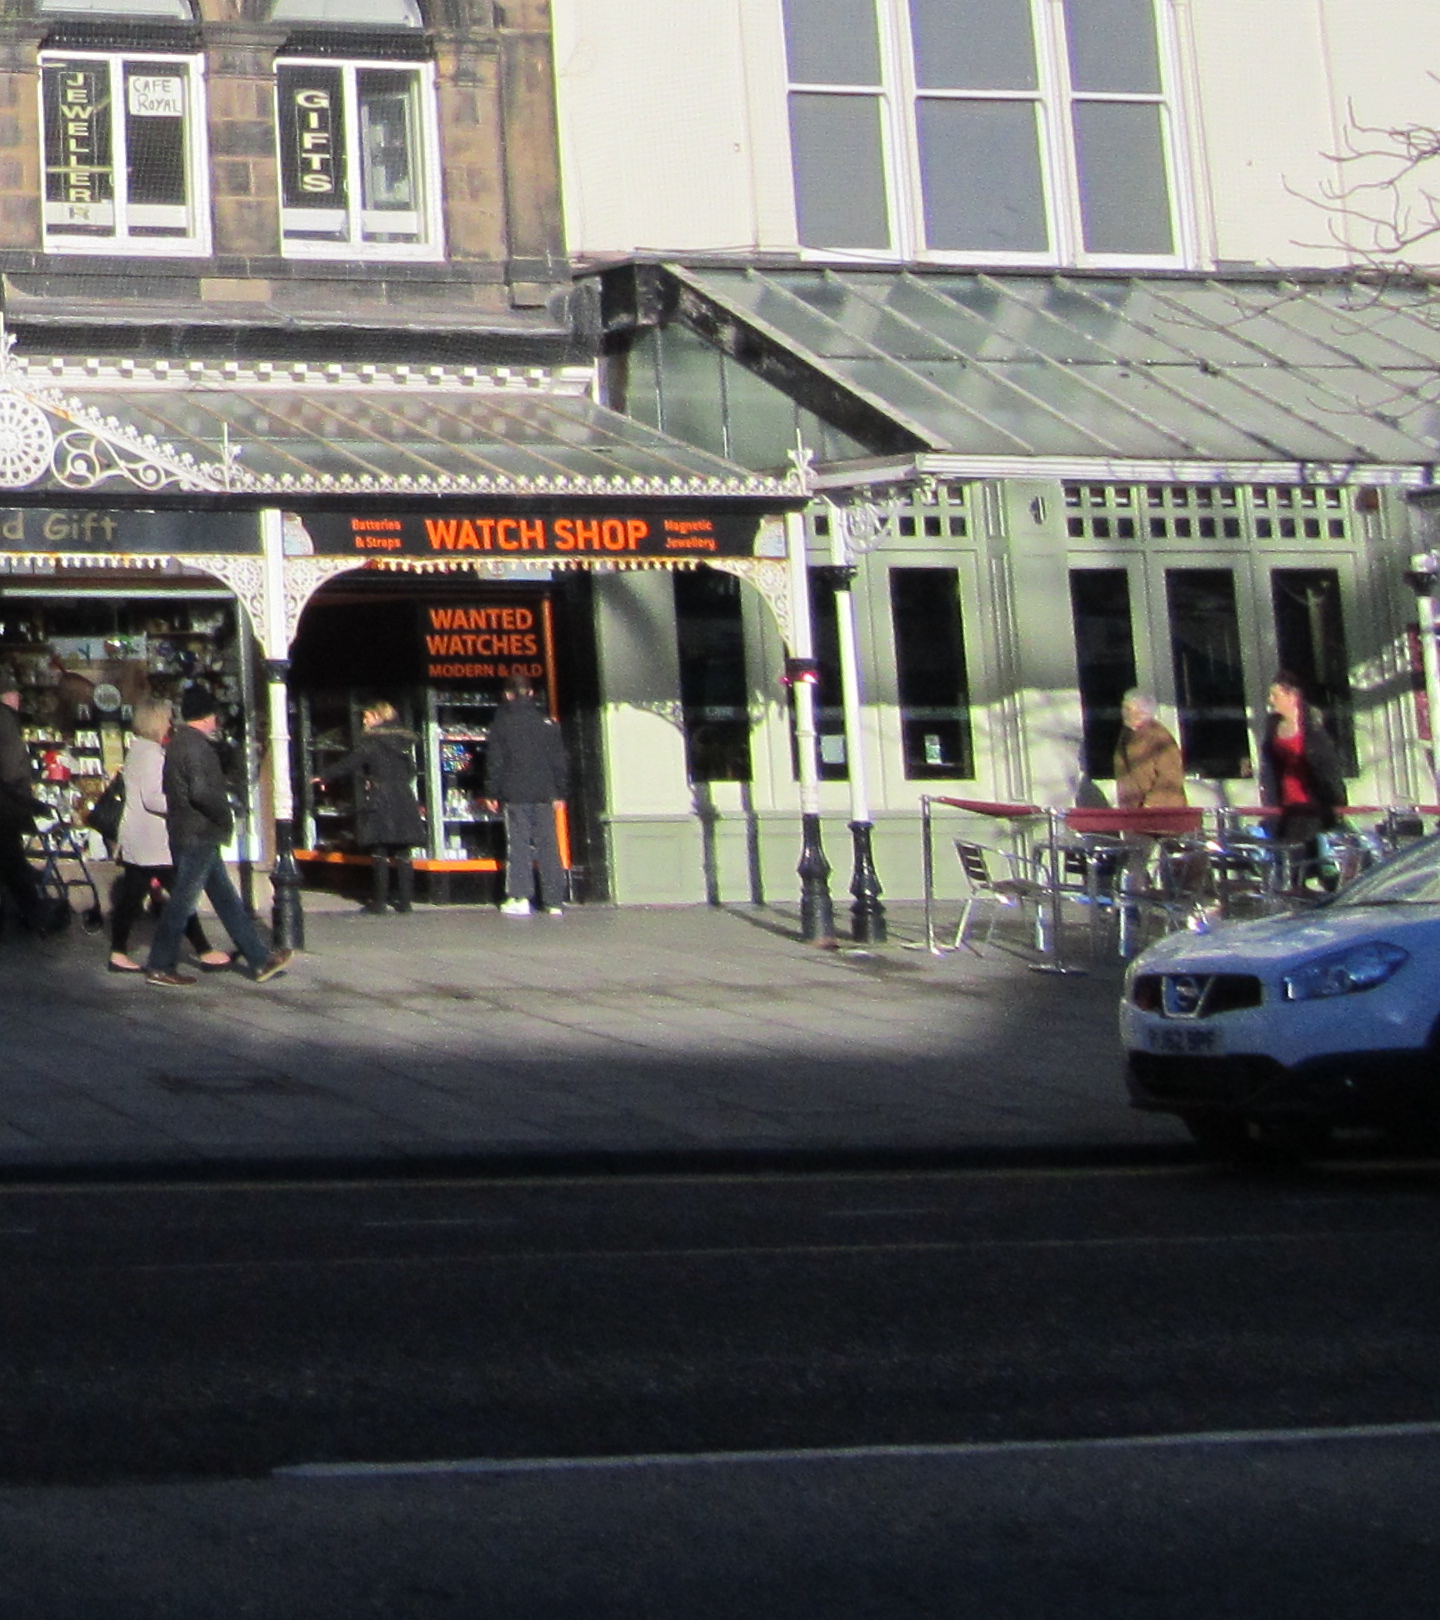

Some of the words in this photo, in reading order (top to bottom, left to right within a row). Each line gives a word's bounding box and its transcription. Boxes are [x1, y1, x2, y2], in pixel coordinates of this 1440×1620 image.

[132, 78, 173, 93] CAFE
[136, 93, 183, 113] ROYAL
[295, 89, 332, 192] GIFTS
[43, 512, 118, 542] Gift
[352, 518, 402, 531] Batteries
[425, 518, 546, 550] WATCH
[553, 518, 650, 550] SHOP
[664, 519, 714, 534] Magnetic
[355, 536, 366, 548] &
[366, 536, 402, 551] Straps
[429, 608, 534, 630] WANTED
[426, 634, 538, 656] WATCHES
[428, 663, 494, 677] MODERN
[497, 663, 509, 677] &
[511, 663, 542, 678] OLD
